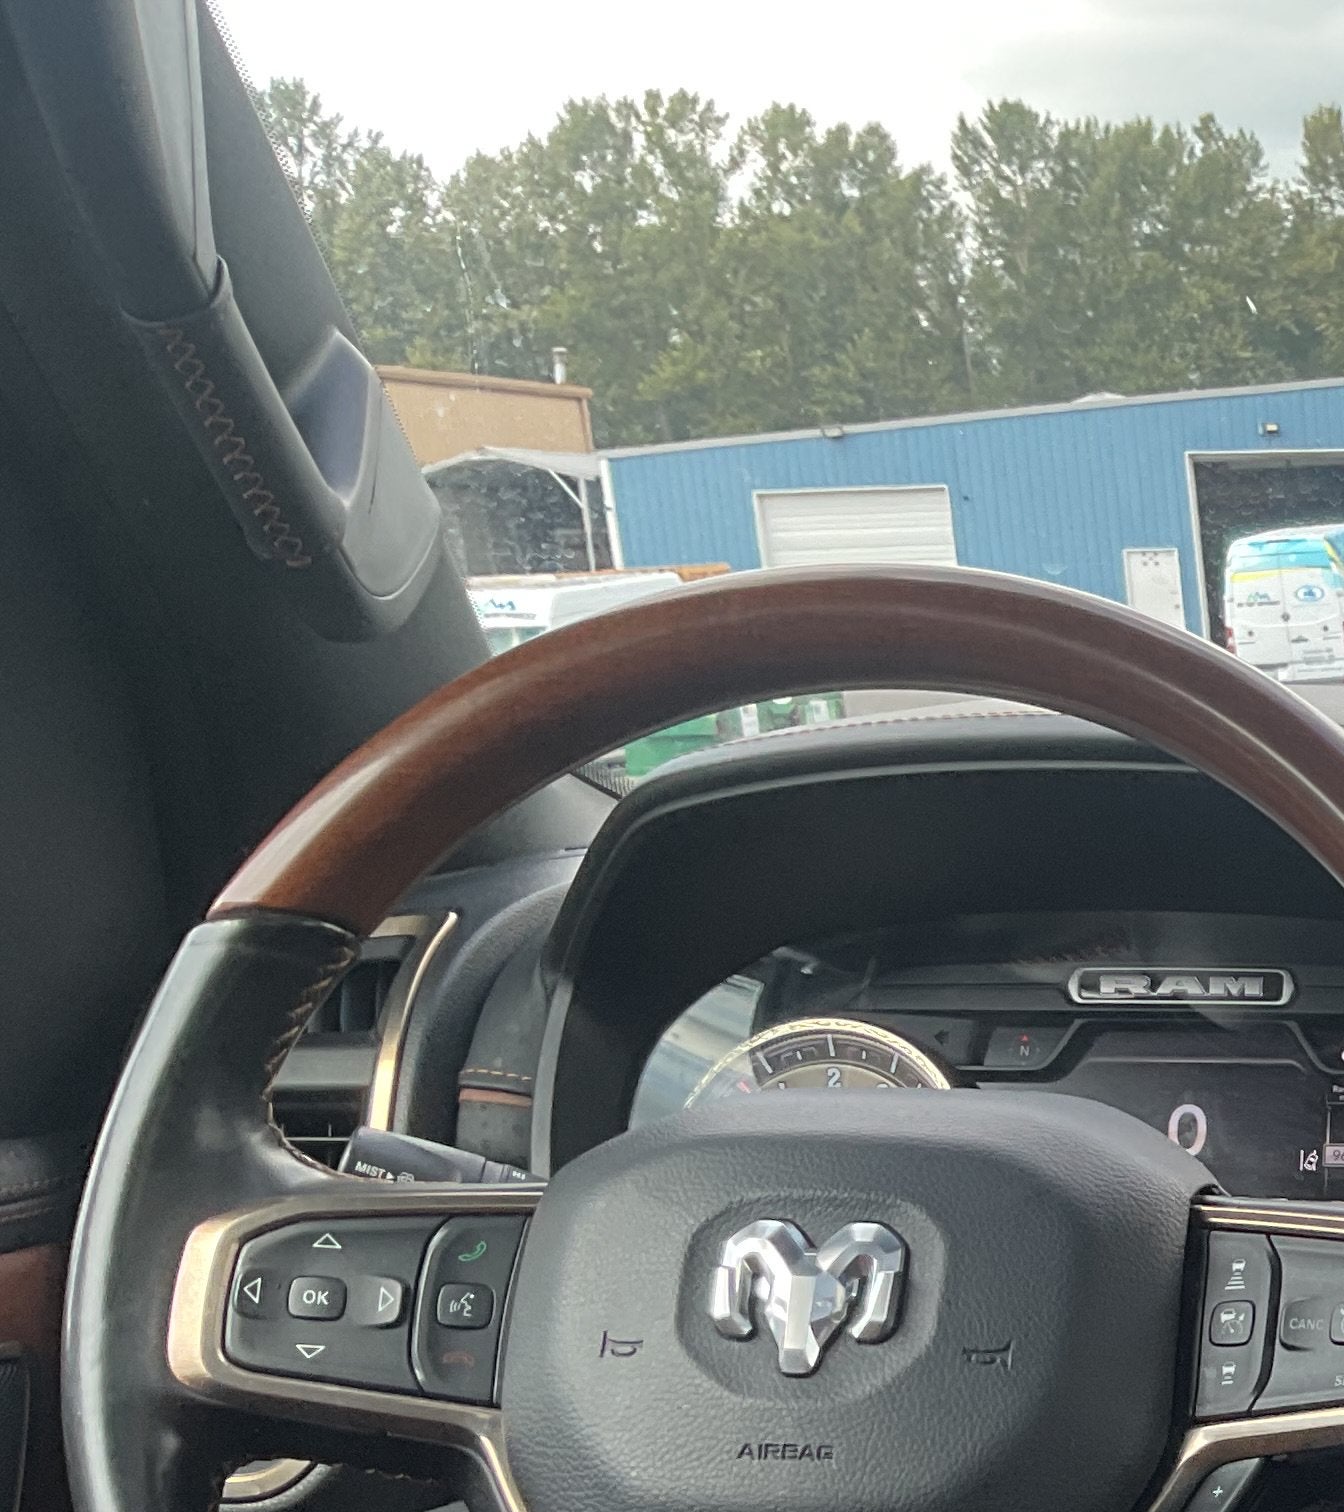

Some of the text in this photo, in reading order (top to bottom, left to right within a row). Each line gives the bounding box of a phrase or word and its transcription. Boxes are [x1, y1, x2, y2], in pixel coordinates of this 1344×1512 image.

[1099, 975, 1264, 997] RAM
[827, 1067, 841, 1088] 2
[354, 1160, 387, 1179] MIST
[302, 1289, 329, 1306] OK
[1289, 1318, 1325, 1330] CANC
[736, 1443, 835, 1461] AIRBAG
